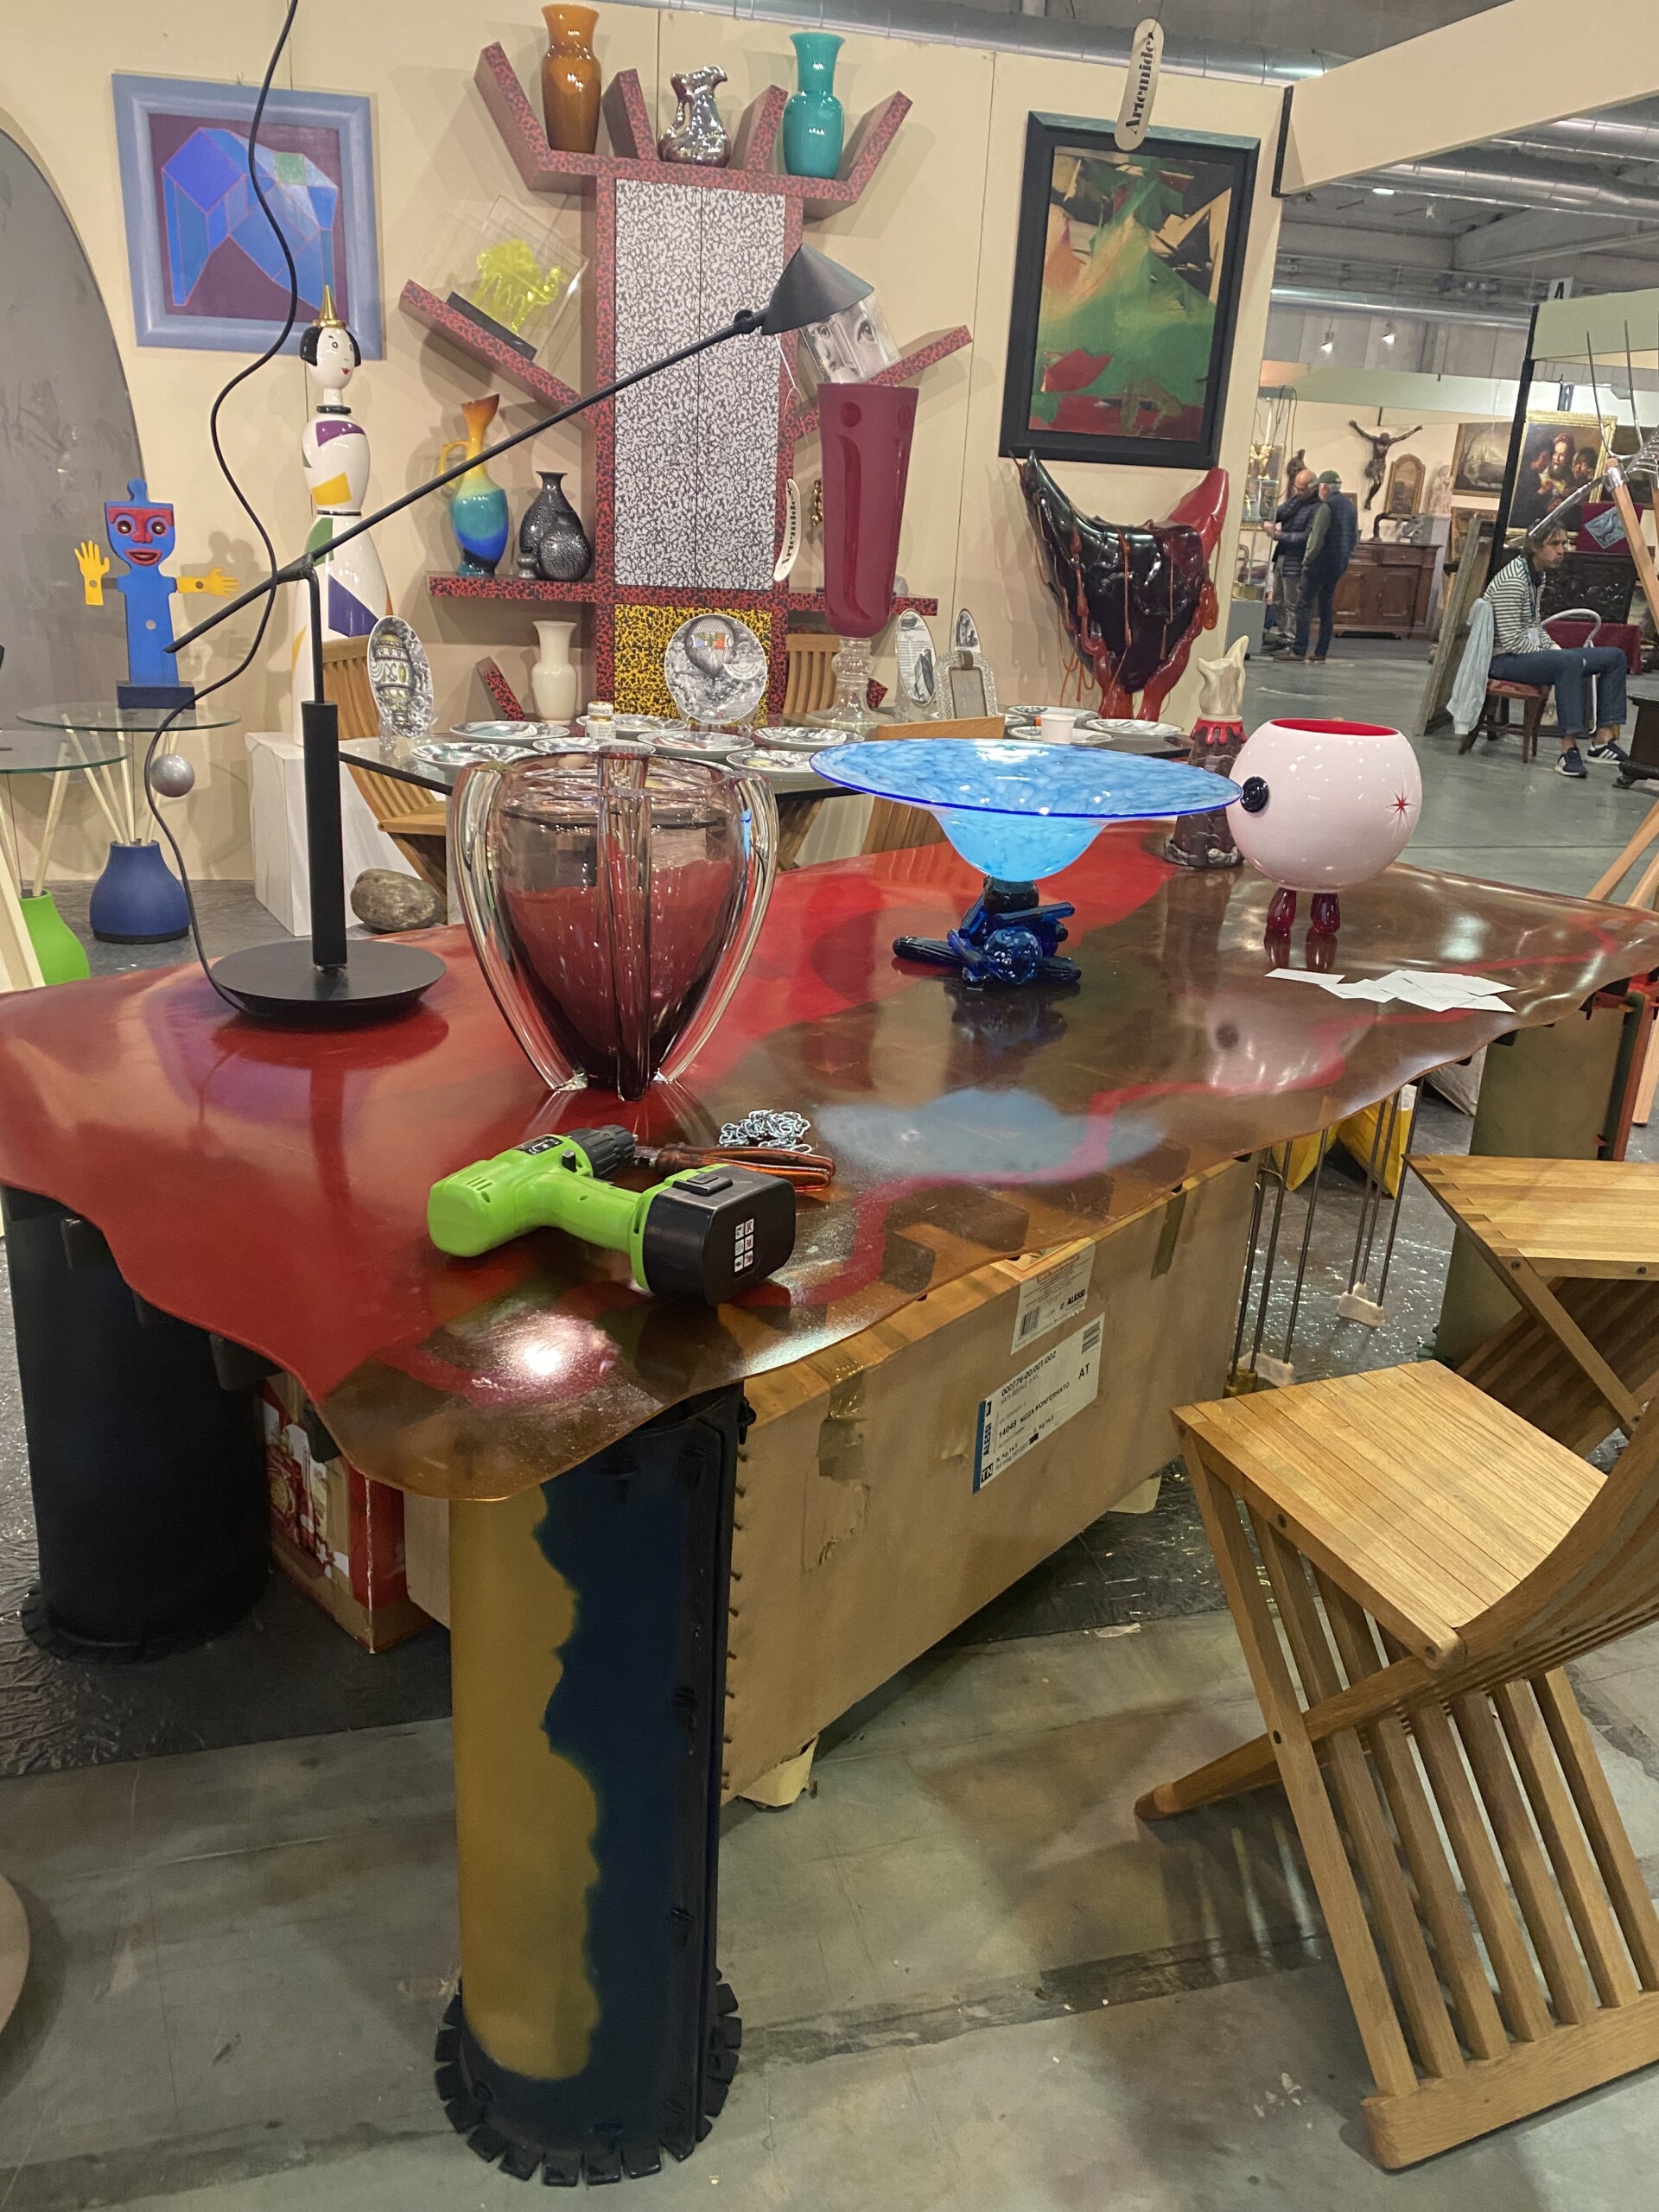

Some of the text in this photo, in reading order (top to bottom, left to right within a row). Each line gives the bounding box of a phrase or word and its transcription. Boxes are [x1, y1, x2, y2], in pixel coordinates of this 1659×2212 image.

[1125, 40, 1154, 136] Artemide
[1066, 1287, 1086, 1306] ALESSI
[1077, 1362, 1091, 1380] AT
[982, 1422, 993, 1456] ALESSI
